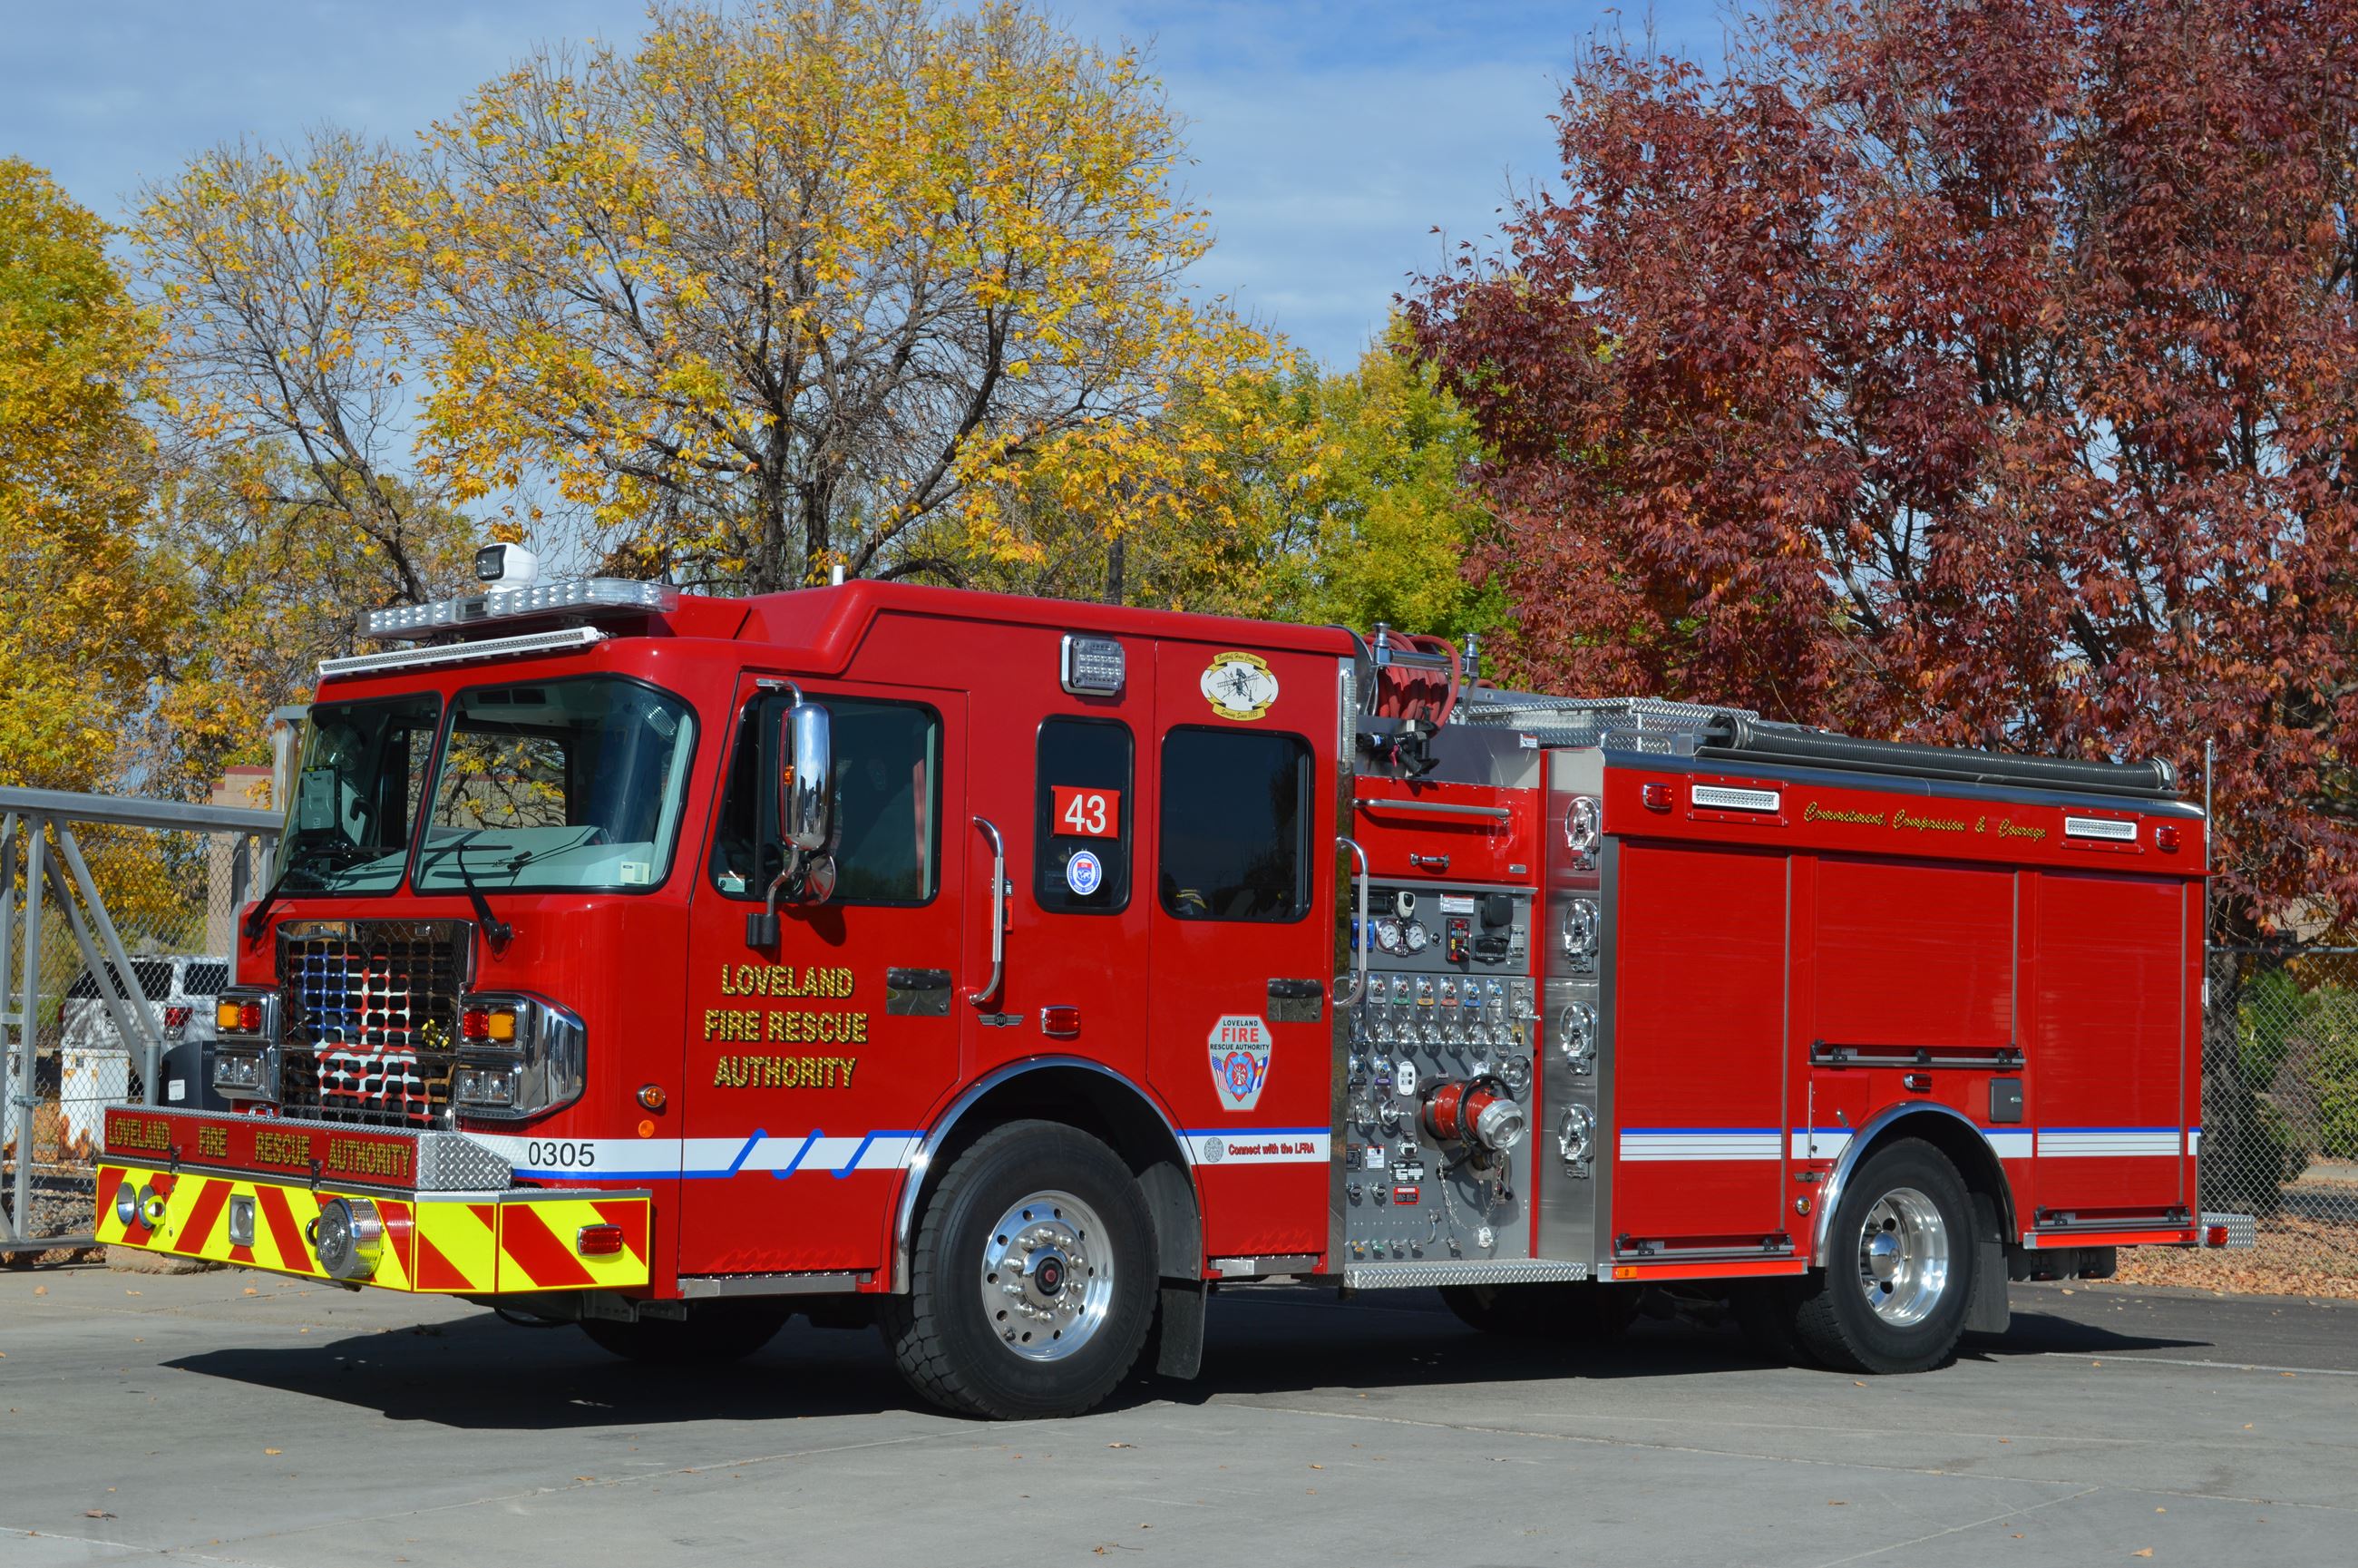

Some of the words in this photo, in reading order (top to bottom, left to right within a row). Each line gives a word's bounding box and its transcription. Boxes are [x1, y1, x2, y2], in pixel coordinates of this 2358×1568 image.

[1065, 794, 1106, 834] 43
[1974, 815, 1986, 833] &
[721, 963, 855, 998] LOVELAND
[704, 1008, 762, 1042] FIRE
[767, 1009, 869, 1044] RESCUE
[1222, 1027, 1260, 1043] FIRE
[713, 1055, 858, 1088] AUTHORITY
[108, 1116, 171, 1151] LOVELAND
[198, 1125, 228, 1157] FIRE
[255, 1131, 311, 1167] RESCUE
[326, 1137, 412, 1178] AUTHORITY
[528, 1141, 595, 1168] 0305
[1228, 1143, 1261, 1156] Connect
[1262, 1143, 1279, 1154] with
[1280, 1142, 1293, 1154] the
[1294, 1142, 1315, 1154] LFRA
